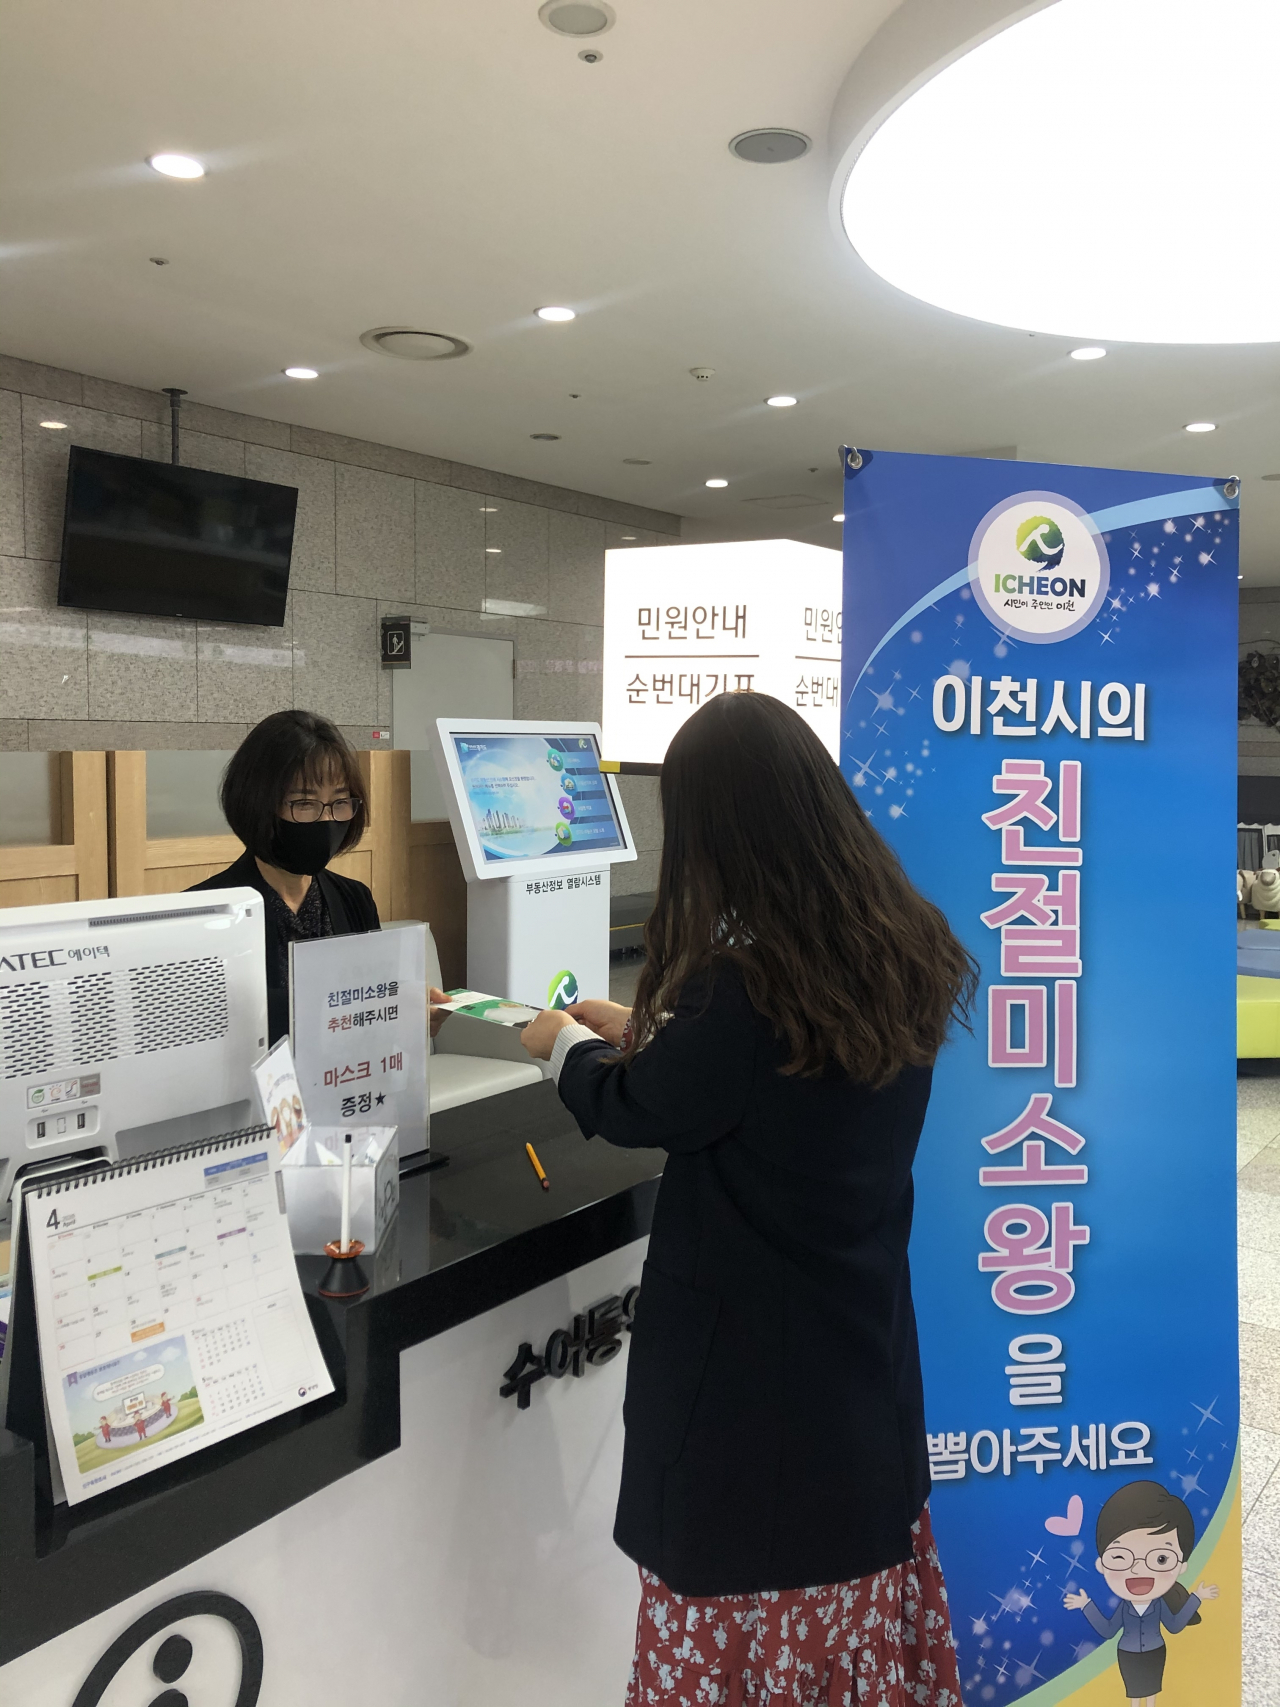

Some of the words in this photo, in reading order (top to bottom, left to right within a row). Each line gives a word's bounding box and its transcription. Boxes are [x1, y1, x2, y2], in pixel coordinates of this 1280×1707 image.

[994, 574, 1086, 598] ICHEON
[1003, 599, 1028, 609] 시민이
[1056, 600, 1075, 611] 이천
[638, 605, 747, 640] 민원안내
[932, 674, 1146, 741] 이천시의
[526, 880, 563, 895] 부동산정보
[566, 874, 601, 889] 열람시스템
[0, 949, 67, 972] ATEC
[68, 945, 110, 961] 에이텍
[327, 980, 399, 1008] 친절미소왕을
[328, 1004, 398, 1033] 추천해주시면
[324, 1060, 371, 1087] 마스크
[380, 1051, 402, 1073] 1매
[46, 1208, 60, 1230] 4
[926, 1421, 1154, 1480] 뽑아주세요
